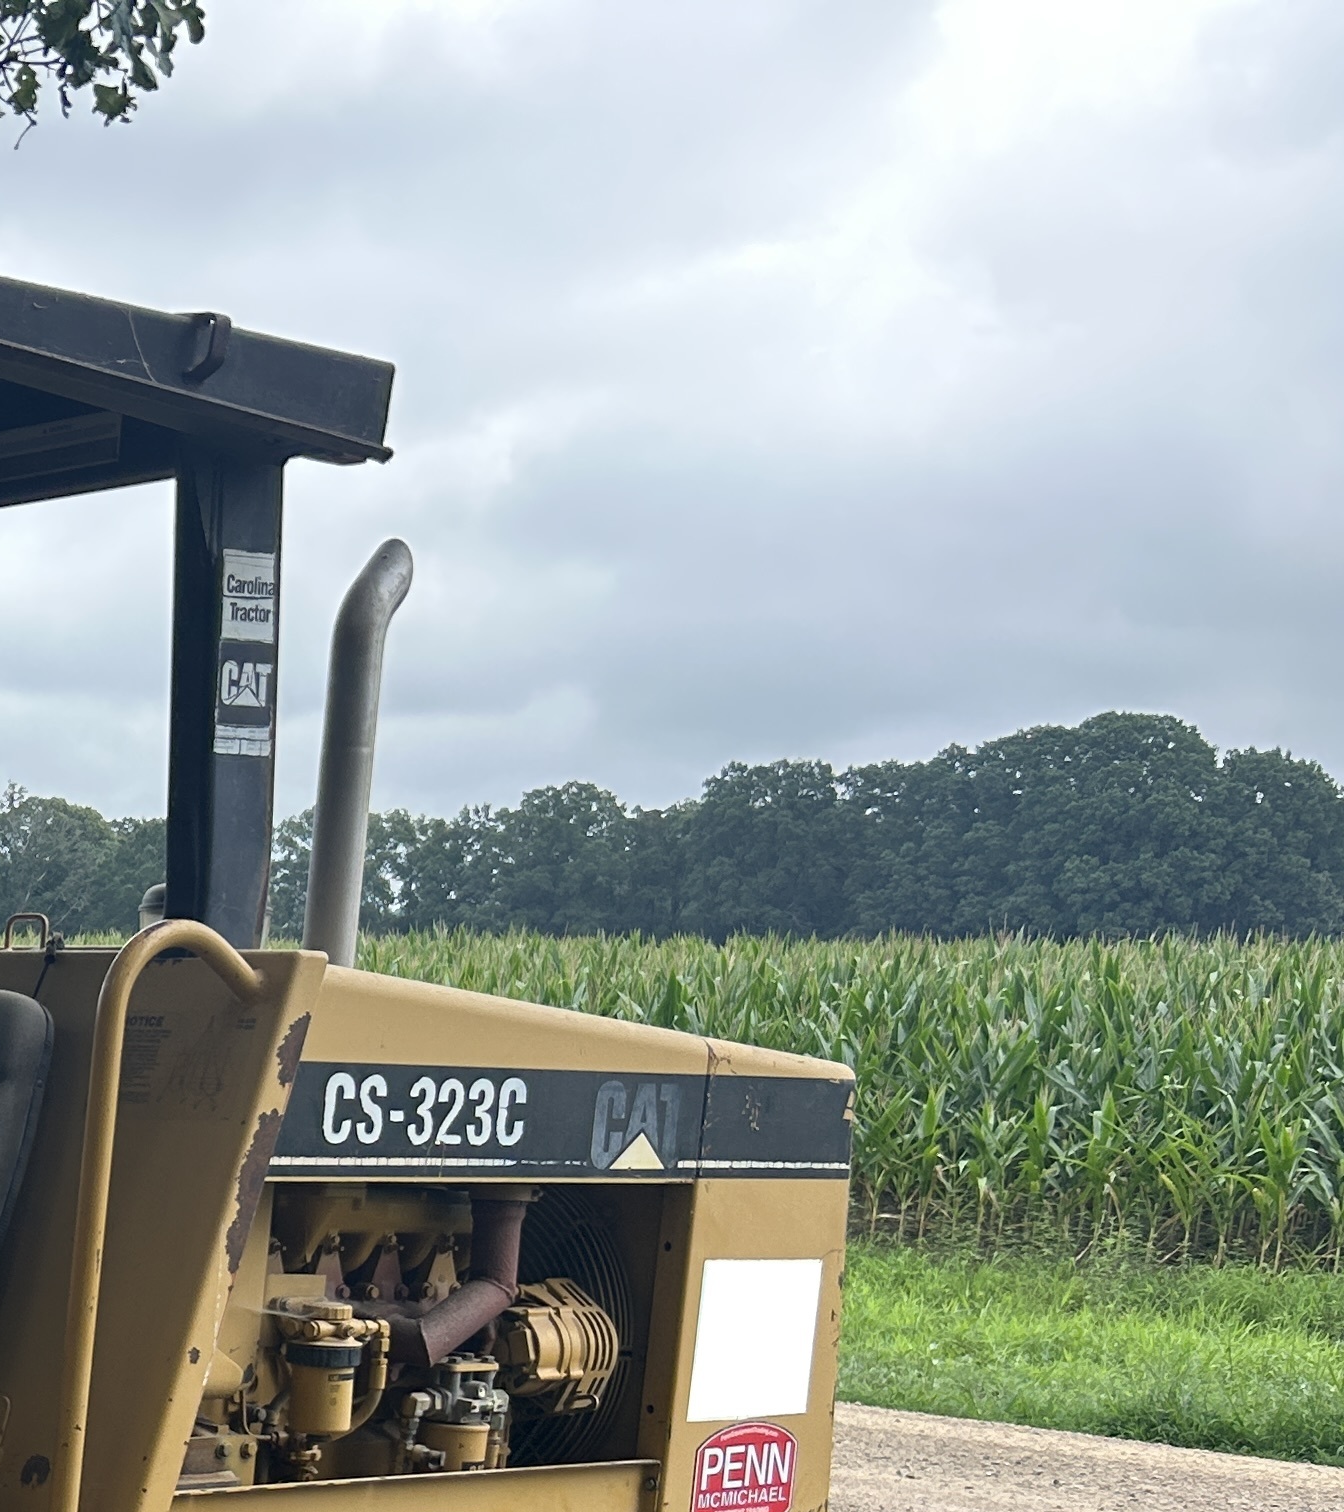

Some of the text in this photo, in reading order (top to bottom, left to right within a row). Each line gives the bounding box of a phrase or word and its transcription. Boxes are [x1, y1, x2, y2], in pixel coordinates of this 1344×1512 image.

[227, 575, 275, 596] Carolina
[230, 602, 271, 622] Tractor
[221, 660, 273, 707] CAT
[322, 1071, 528, 1147] CS-323C
[590, 1080, 681, 1170] CAT
[700, 1441, 792, 1490] PENN
[698, 1486, 787, 1509] MCMICHAEL
